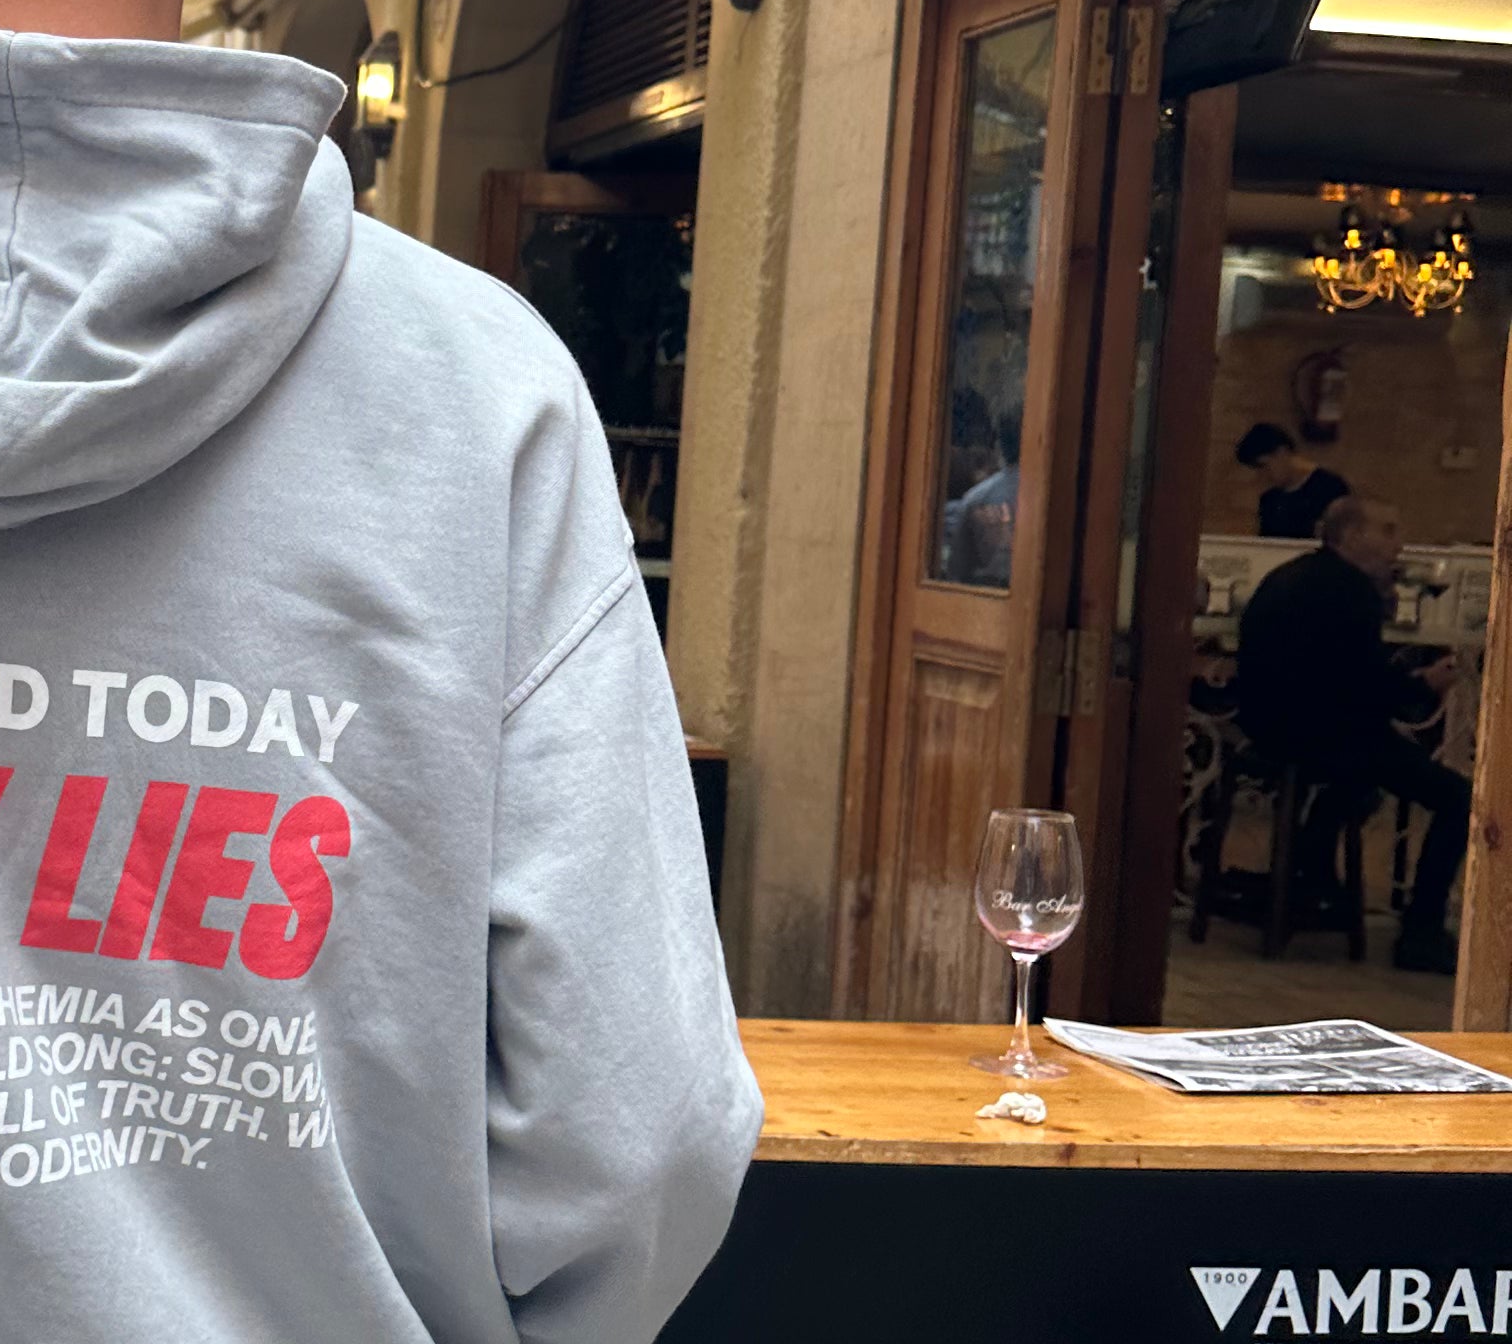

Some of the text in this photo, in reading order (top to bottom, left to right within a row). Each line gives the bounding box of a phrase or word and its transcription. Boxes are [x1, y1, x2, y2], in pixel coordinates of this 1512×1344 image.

[72, 669, 359, 763] TODAY
[20, 774, 351, 981] LIES
[991, 889, 1032, 912] Bar
[34, 1031, 173, 1081] SONG:
[134, 998, 210, 1038] AS
[220, 1009, 317, 1056] ONE
[50, 1081, 87, 1127] OF
[97, 1079, 269, 1142] TRUTH.
[288, 1102, 336, 1149] W
[1203, 1272, 1248, 1284] 1900
